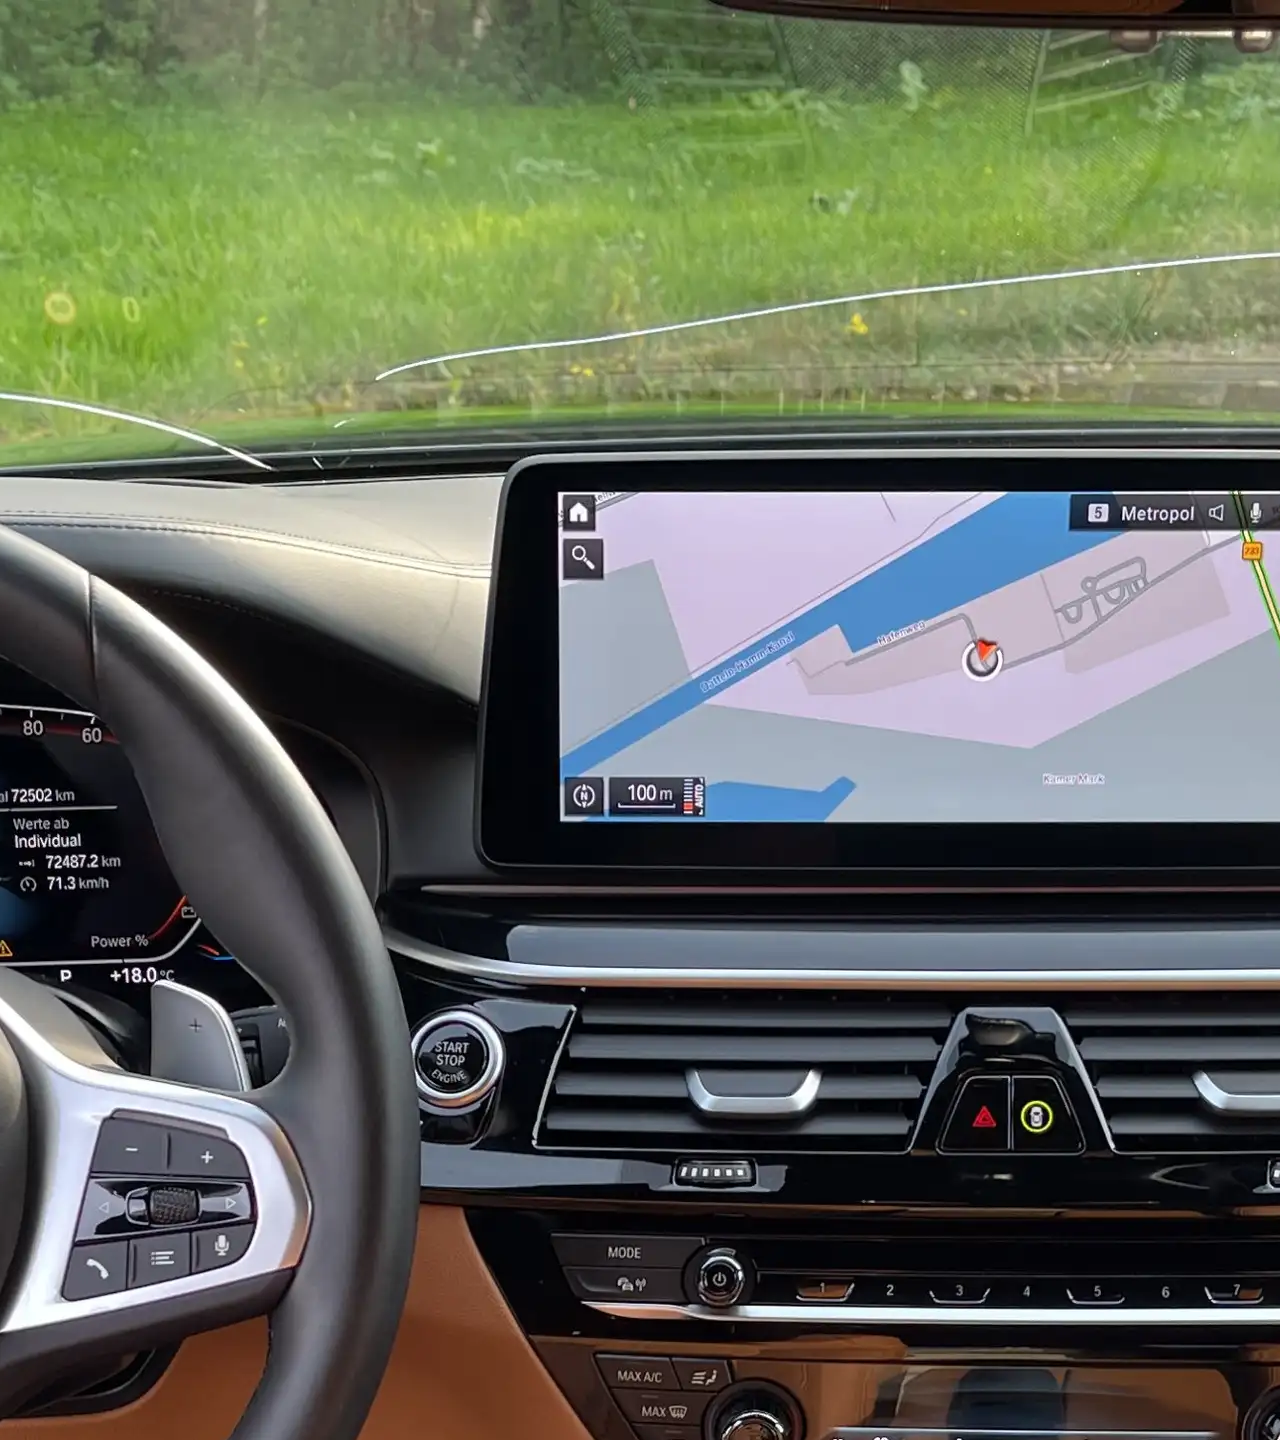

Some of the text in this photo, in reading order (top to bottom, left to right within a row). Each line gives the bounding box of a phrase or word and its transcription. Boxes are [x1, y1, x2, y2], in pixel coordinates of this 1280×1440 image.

[1121, 504, 1195, 525] Metropol
[23, 720, 44, 736] 80
[82, 728, 102, 743] 60
[11, 788, 53, 802] 72502
[55, 789, 75, 802] km
[628, 784, 672, 801] 100 m
[694, 784, 704, 807] AUTO
[12, 817, 70, 830] Werte ab
[14, 834, 81, 848] Individual
[46, 854, 121, 869] 72487.2 km
[47, 876, 110, 890] 71.3 km/h
[91, 935, 148, 948] Power %
[60, 970, 72, 982] P
[110, 968, 157, 984] +18.0
[435, 1041, 470, 1054] START
[436, 1054, 466, 1066] STOP
[431, 1068, 468, 1084] ENGINE
[607, 1246, 642, 1260] MODE
[886, 1284, 894, 1296] 2
[956, 1284, 964, 1296] 3
[1023, 1285, 1031, 1297] 4
[1094, 1285, 1102, 1298] 5
[1162, 1286, 1170, 1298] 6
[1234, 1284, 1241, 1296] 7
[618, 1370, 662, 1384] MAX A/C
[641, 1406, 666, 1418] MAX
